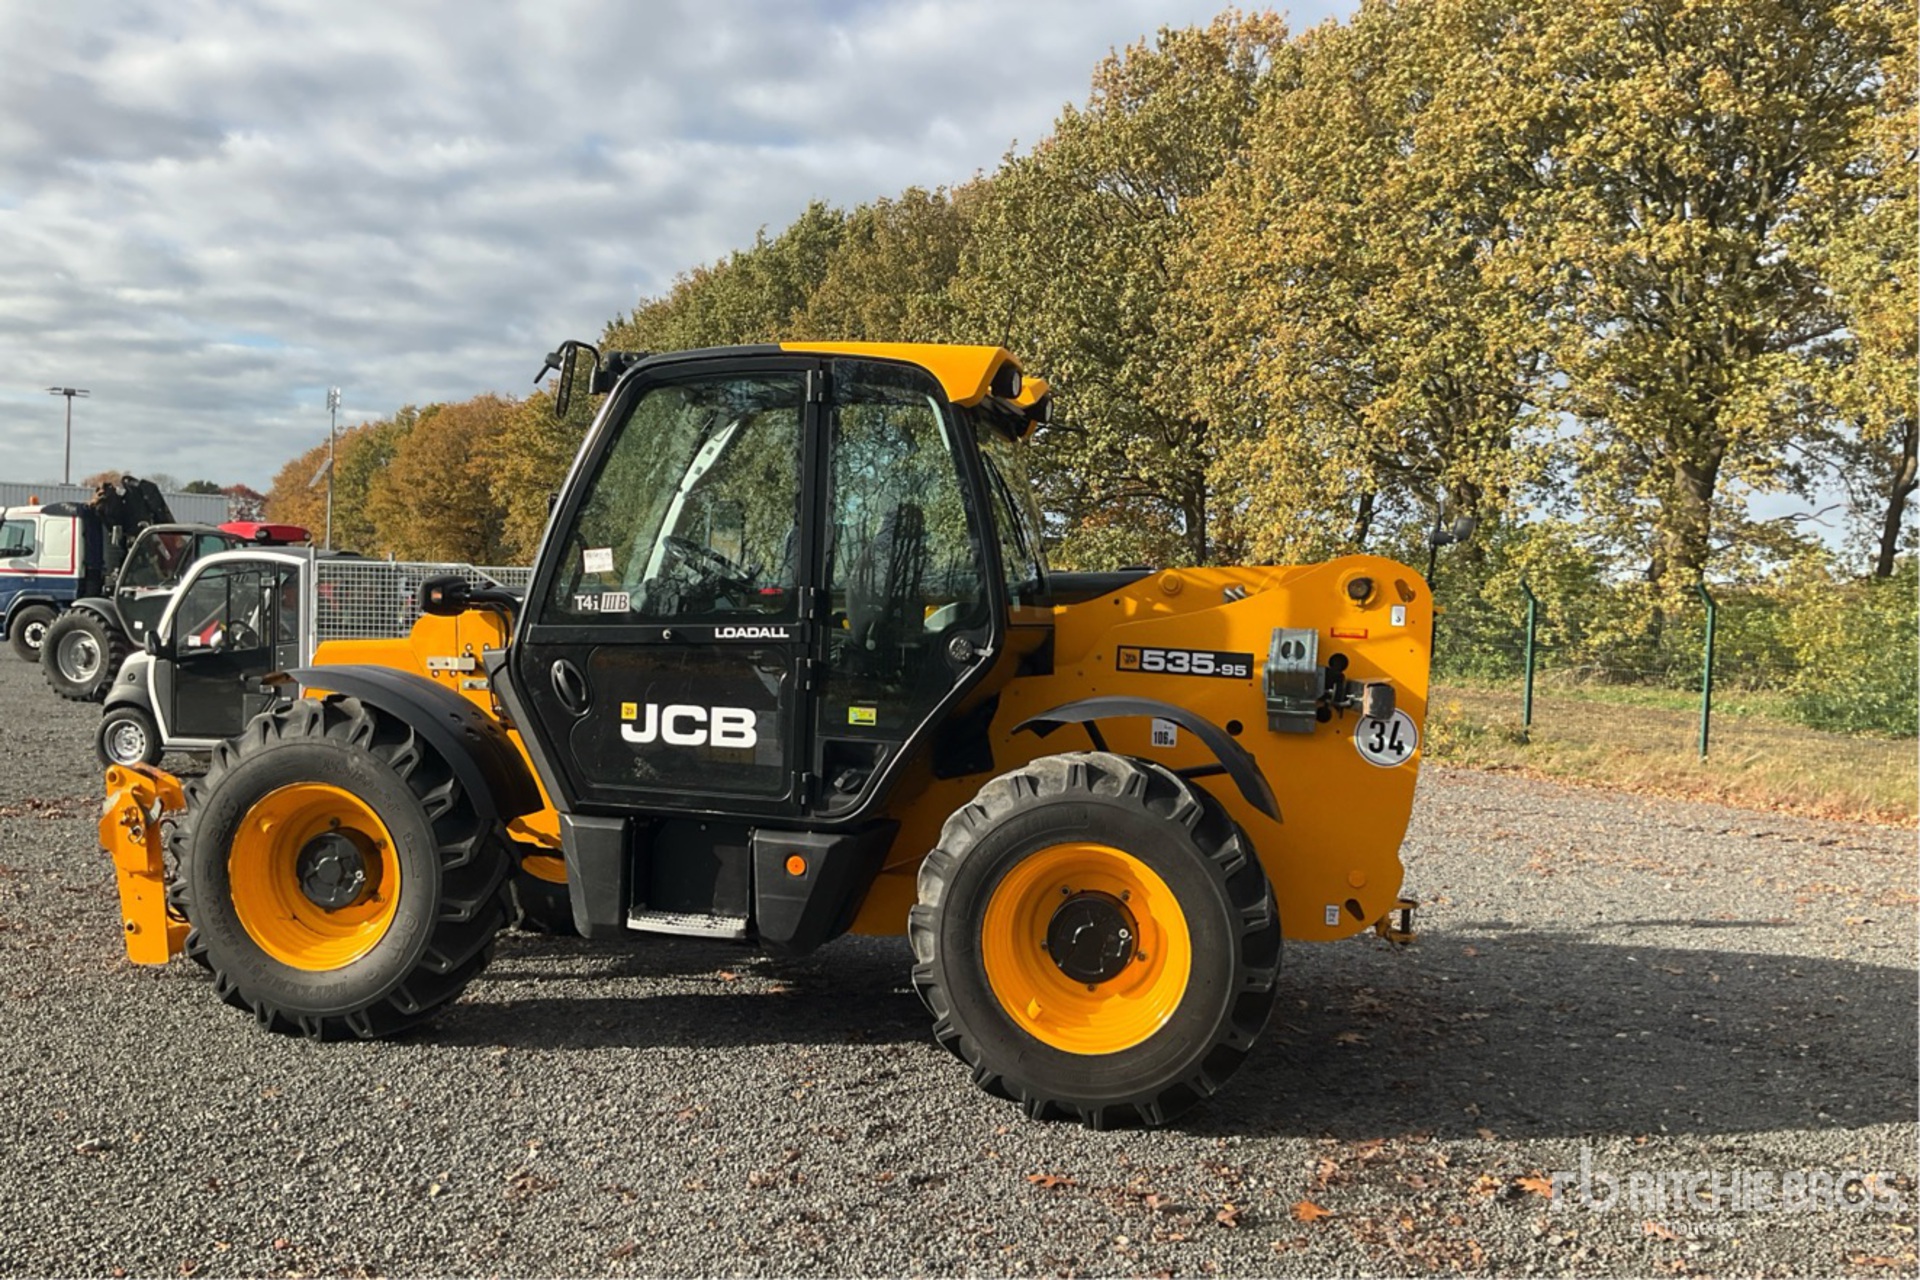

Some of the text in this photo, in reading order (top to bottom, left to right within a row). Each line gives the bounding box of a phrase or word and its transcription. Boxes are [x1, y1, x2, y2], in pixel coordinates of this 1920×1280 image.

[574, 594, 628, 611] T4i IIIB
[715, 627, 789, 638] LOADALL
[1142, 650, 1247, 676] 535-95
[621, 703, 757, 748] JCB
[1154, 731, 1169, 745] 106
[1368, 720, 1404, 755] 34
